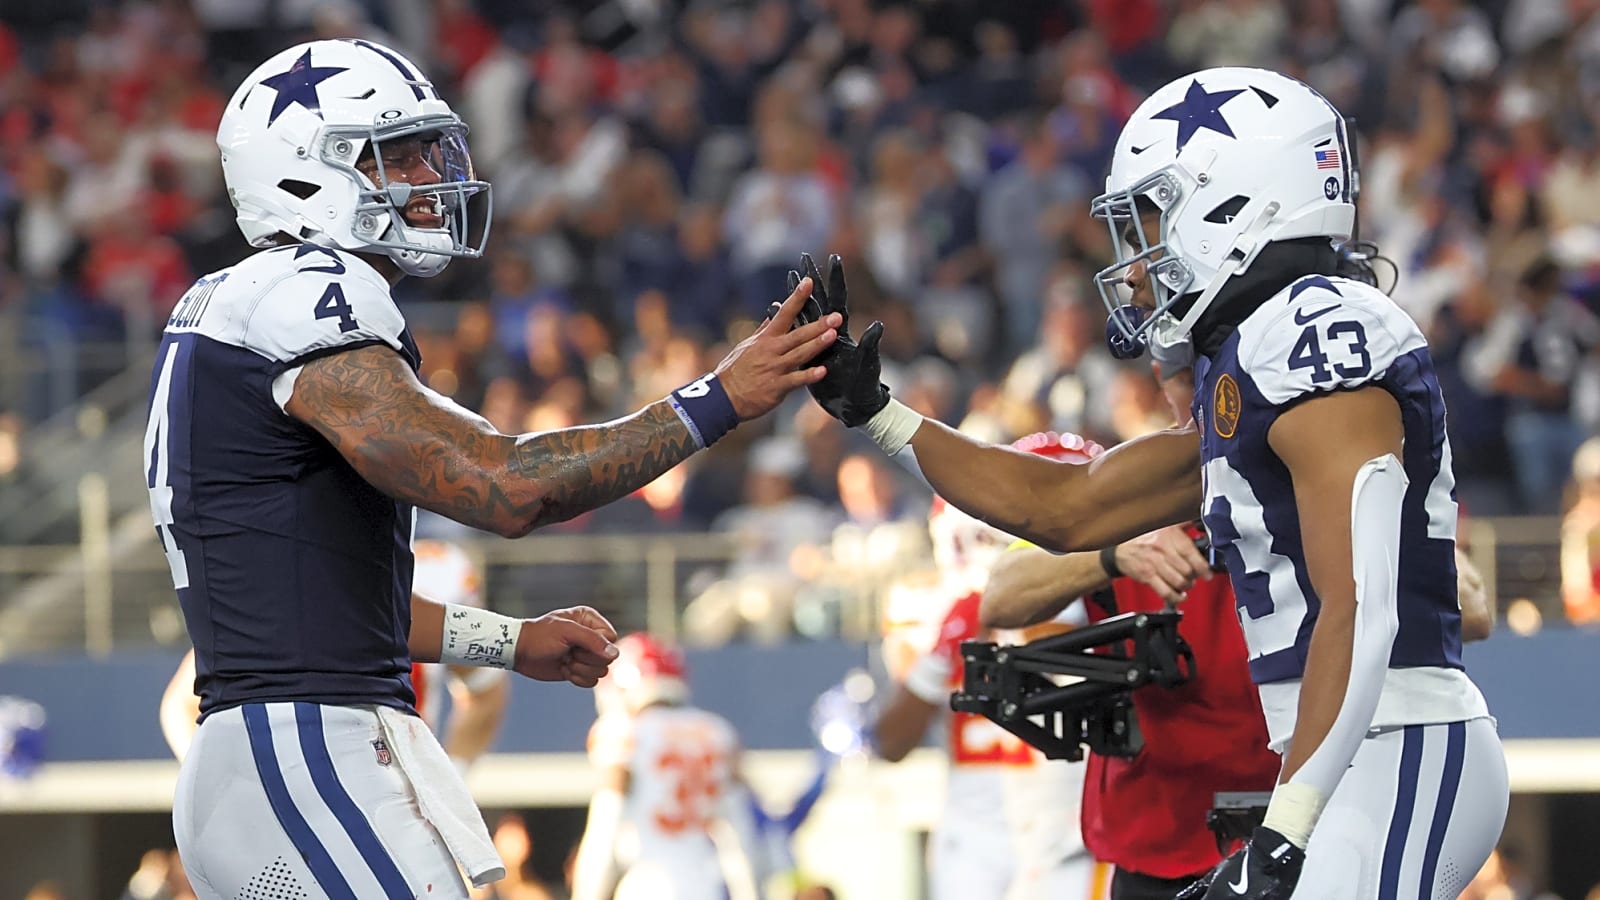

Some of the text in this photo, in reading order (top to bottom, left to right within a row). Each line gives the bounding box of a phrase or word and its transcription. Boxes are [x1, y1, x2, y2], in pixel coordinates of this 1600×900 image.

[1325, 182, 1338, 195] 94
[314, 281, 359, 334] 4
[1287, 319, 1372, 384] 43
[143, 341, 190, 590] 4
[1201, 455, 1308, 662] 3
[467, 643, 504, 657] FAITH
